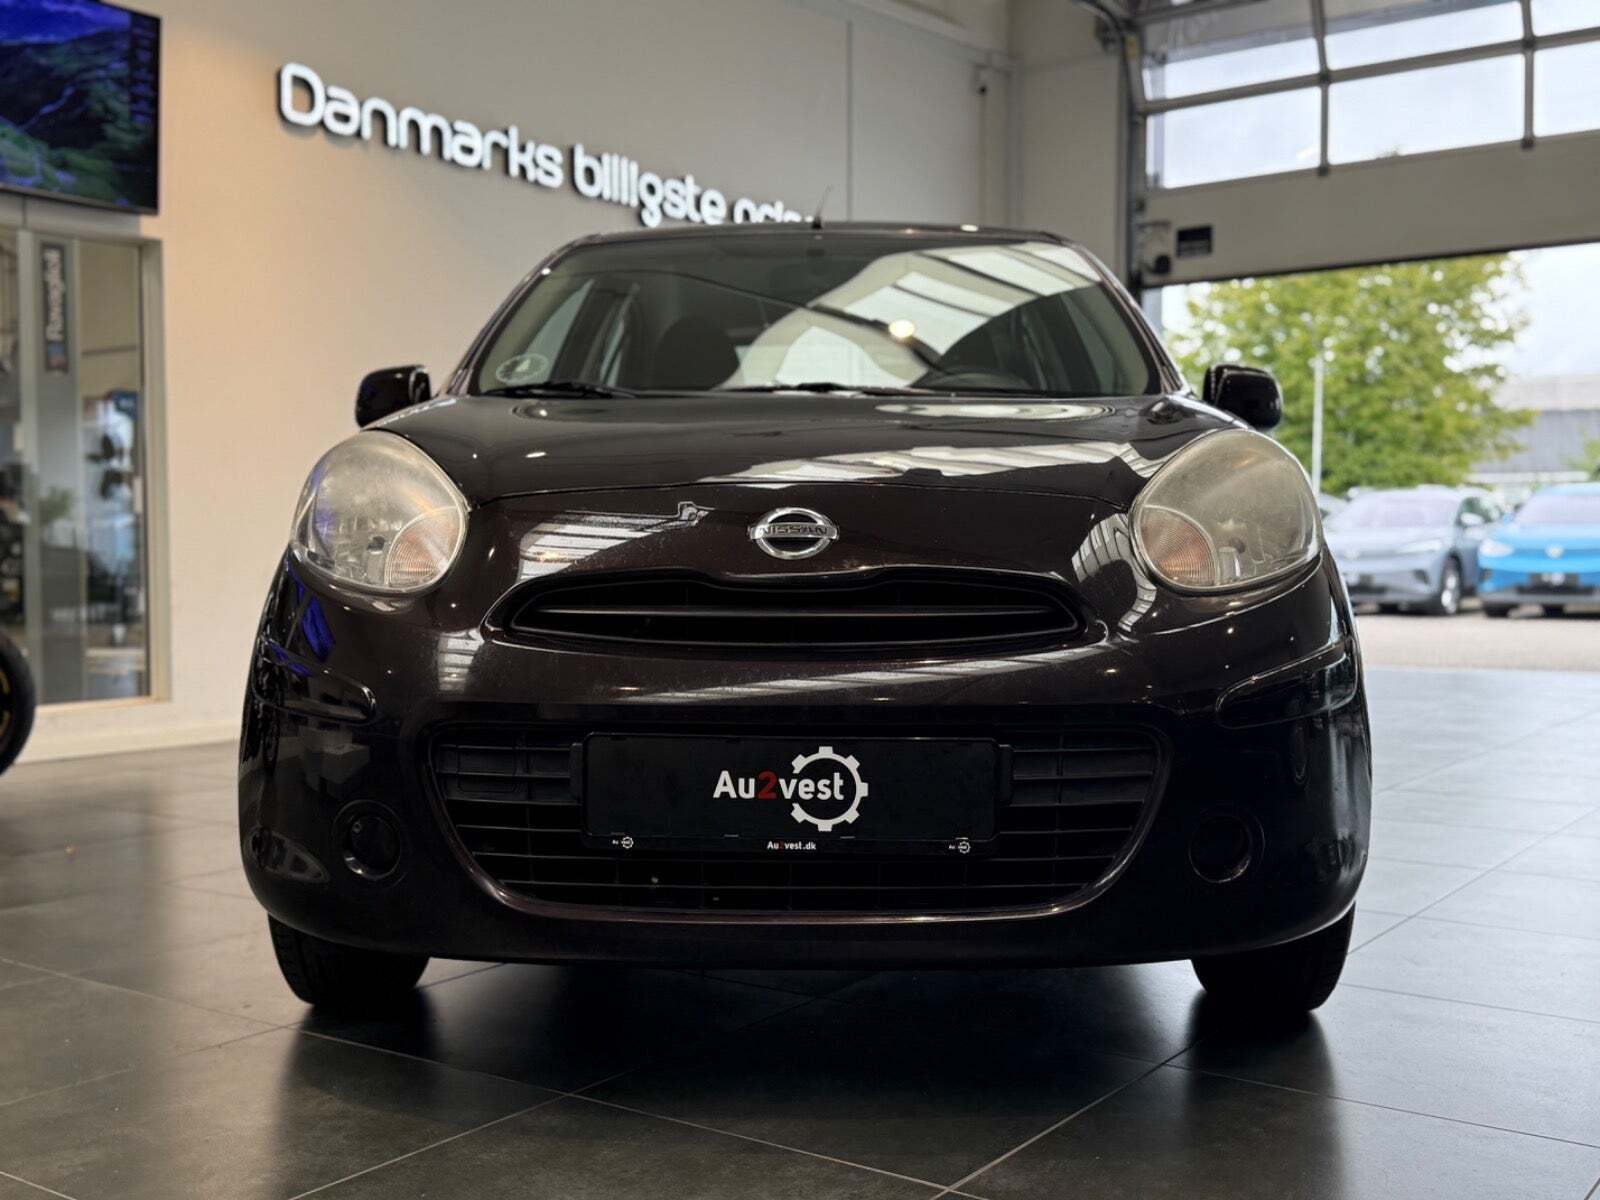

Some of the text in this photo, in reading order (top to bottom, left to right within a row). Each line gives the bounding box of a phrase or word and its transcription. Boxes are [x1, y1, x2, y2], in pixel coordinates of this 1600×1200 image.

[280, 62, 564, 188] Danmarks
[763, 525, 828, 535] NISSAN
[713, 770, 845, 800] Au2vest
